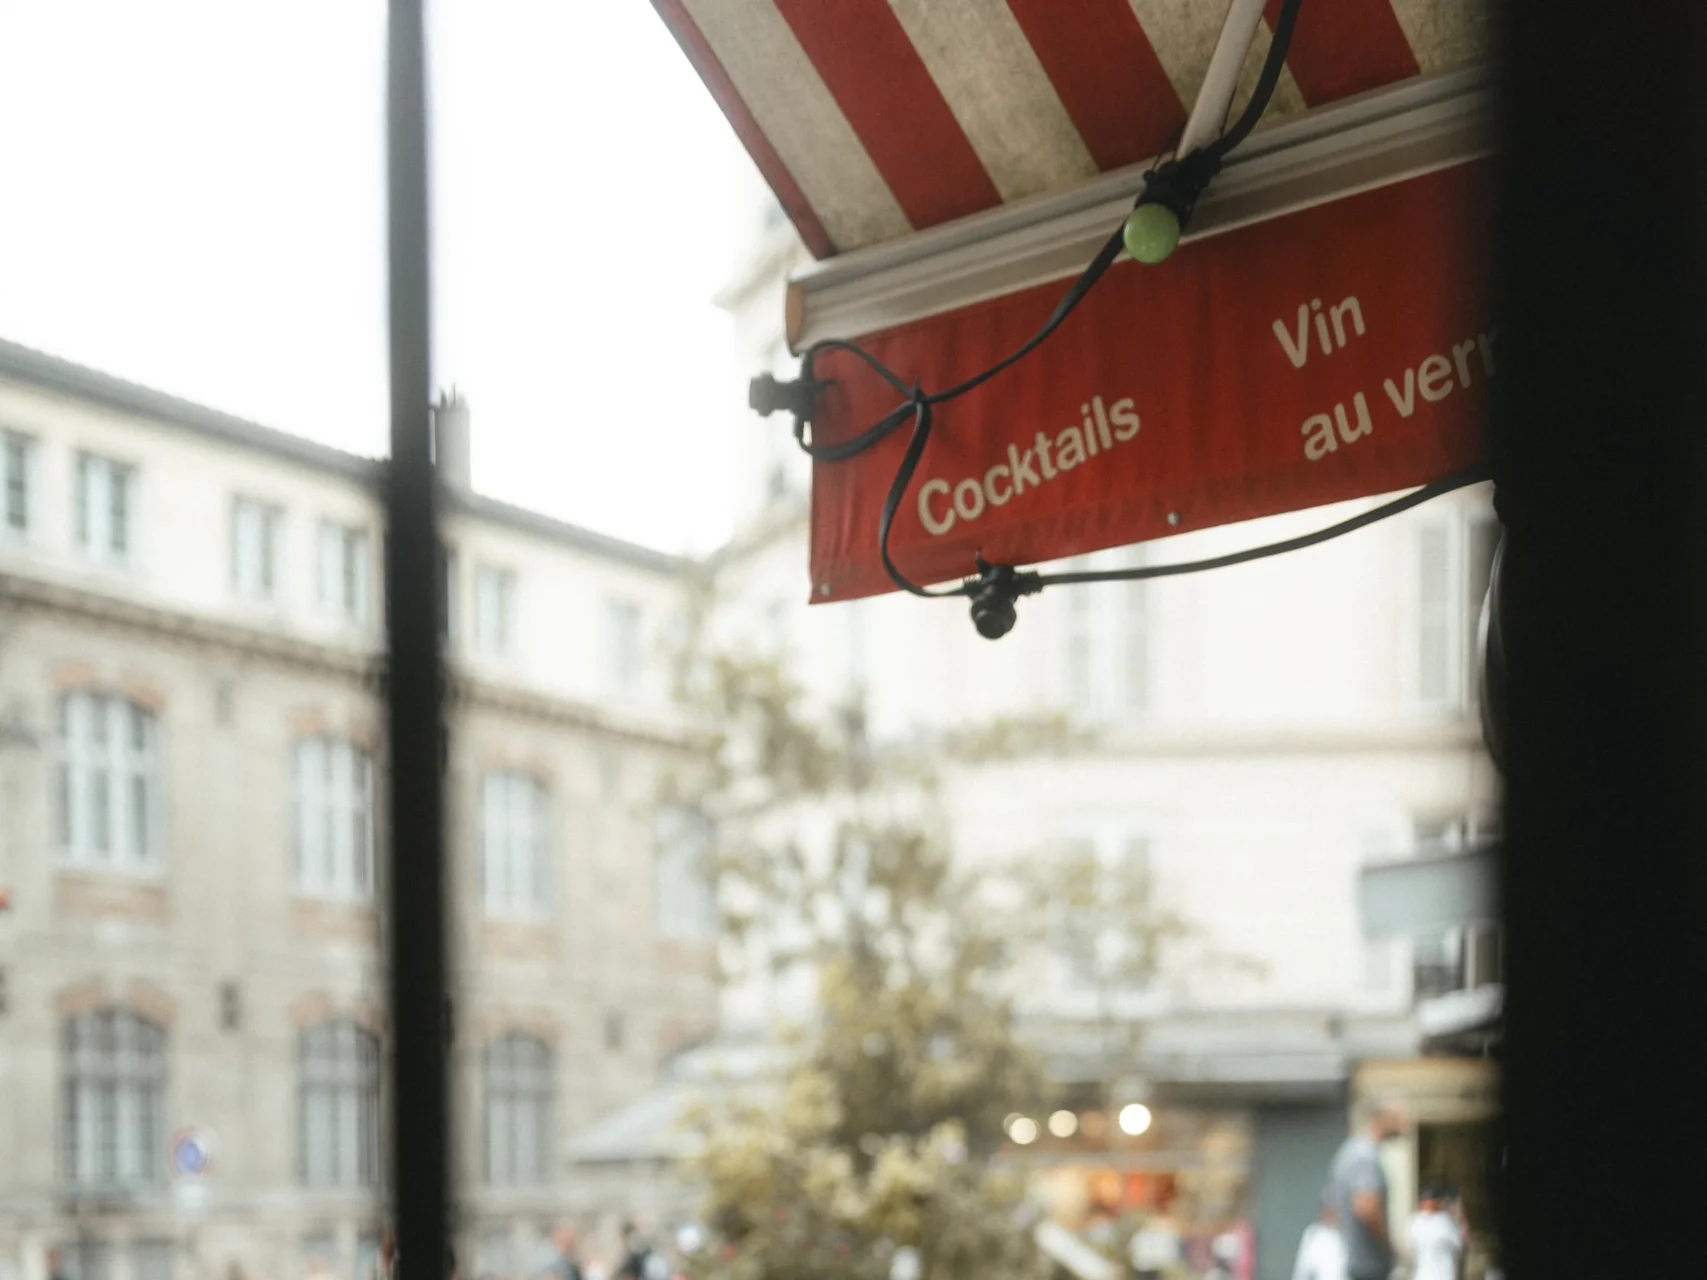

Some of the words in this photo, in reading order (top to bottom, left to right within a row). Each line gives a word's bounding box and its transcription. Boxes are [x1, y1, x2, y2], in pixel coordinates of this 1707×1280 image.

[1271, 295, 1366, 369] Vin
[1300, 391, 1374, 462] au
[917, 395, 1141, 535] Cocktails
